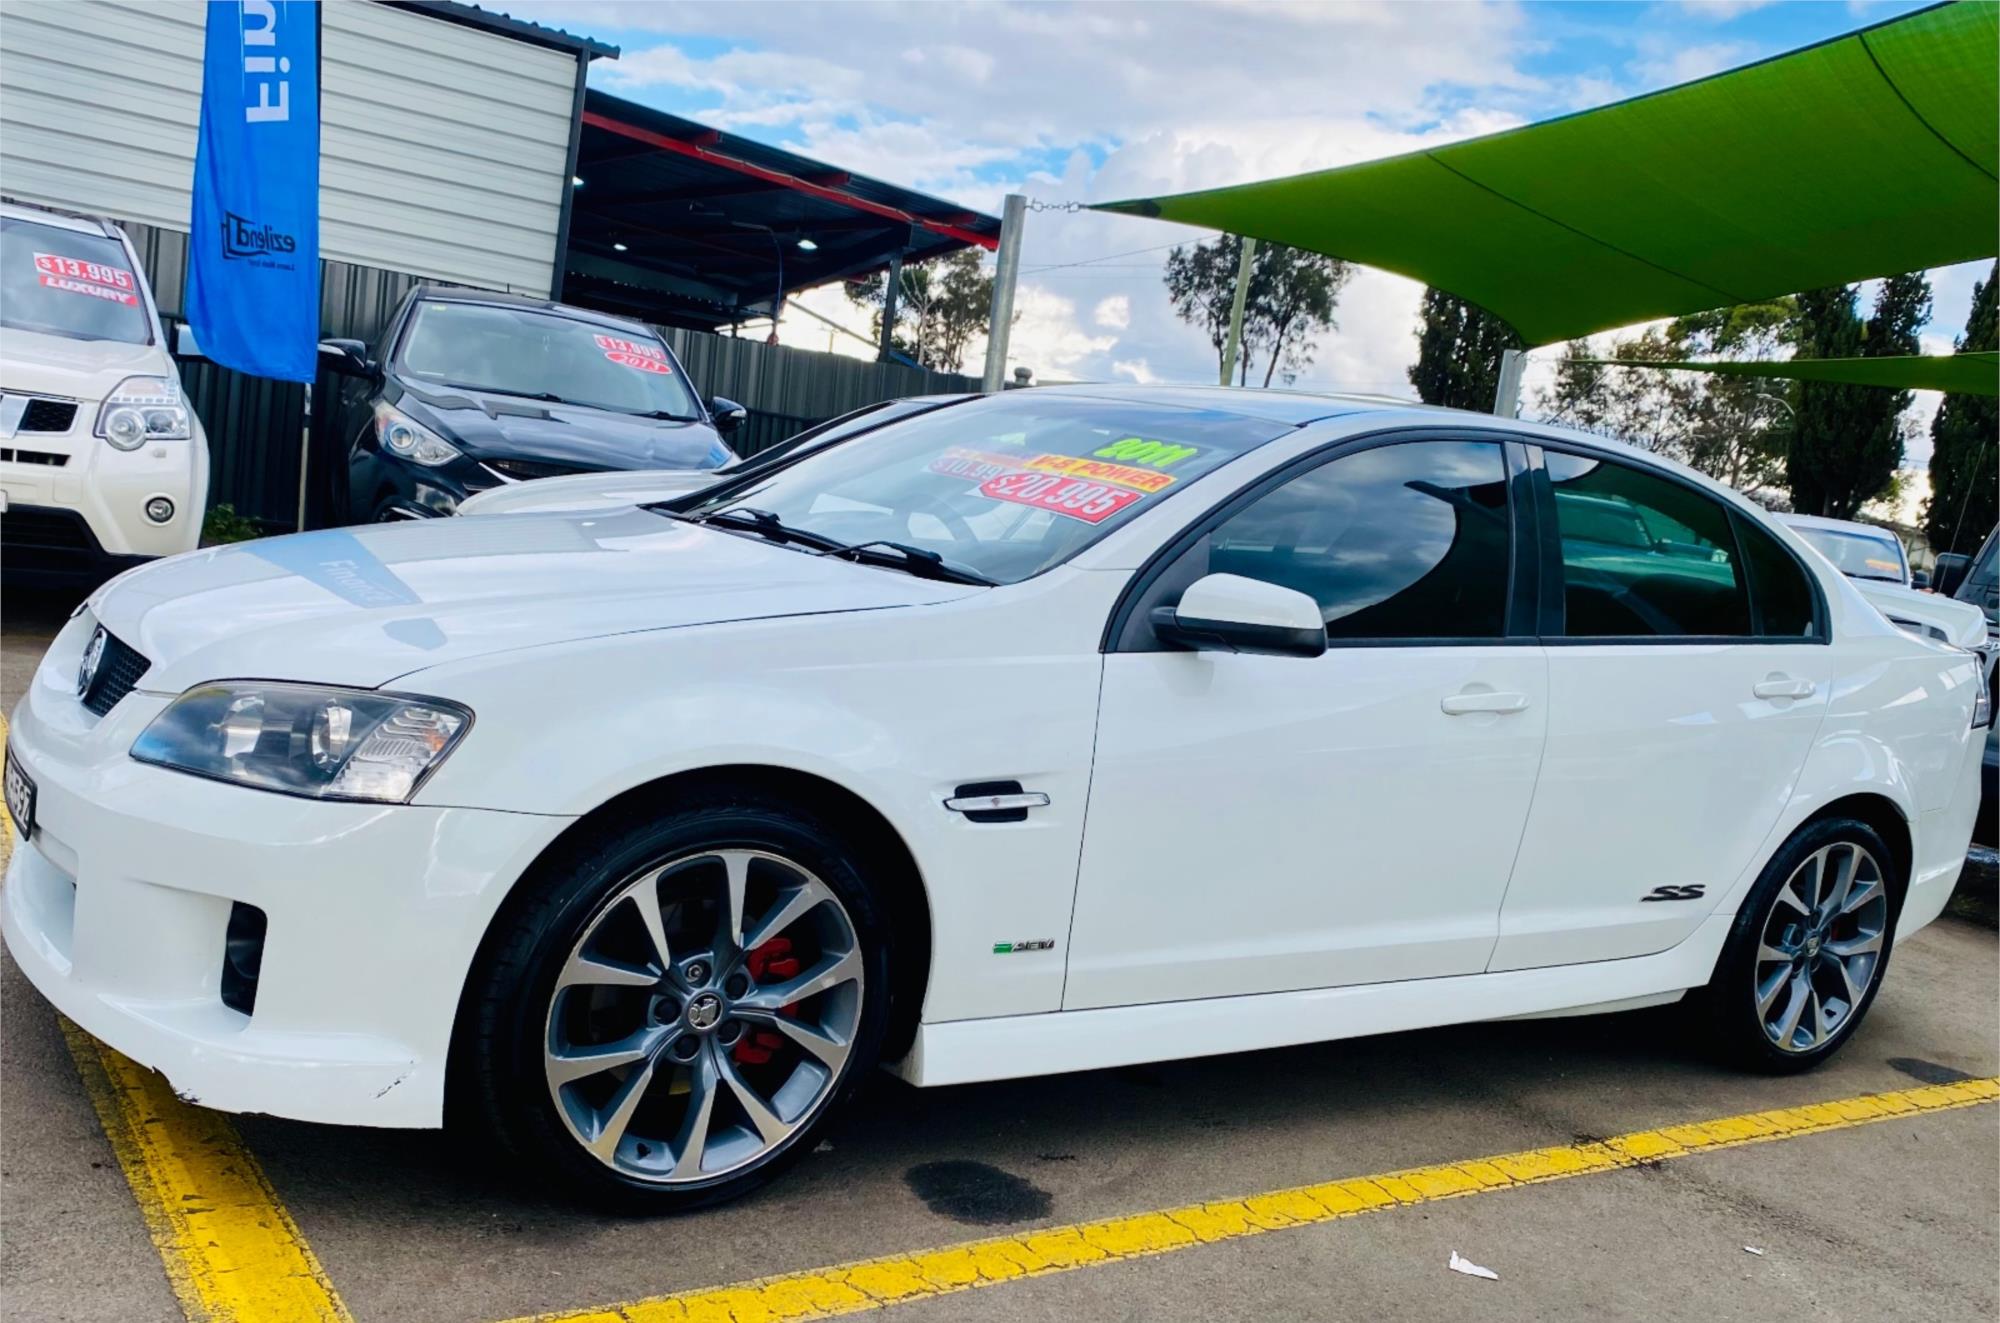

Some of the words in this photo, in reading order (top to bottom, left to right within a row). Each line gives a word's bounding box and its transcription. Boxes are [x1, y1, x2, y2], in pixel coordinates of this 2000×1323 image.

[47, 276, 128, 304] LUXURY
[1093, 438, 1198, 468] 2011
[1071, 461, 1171, 490] POWER
[988, 473, 1132, 515] $20,995
[1640, 884, 1706, 902] SS
